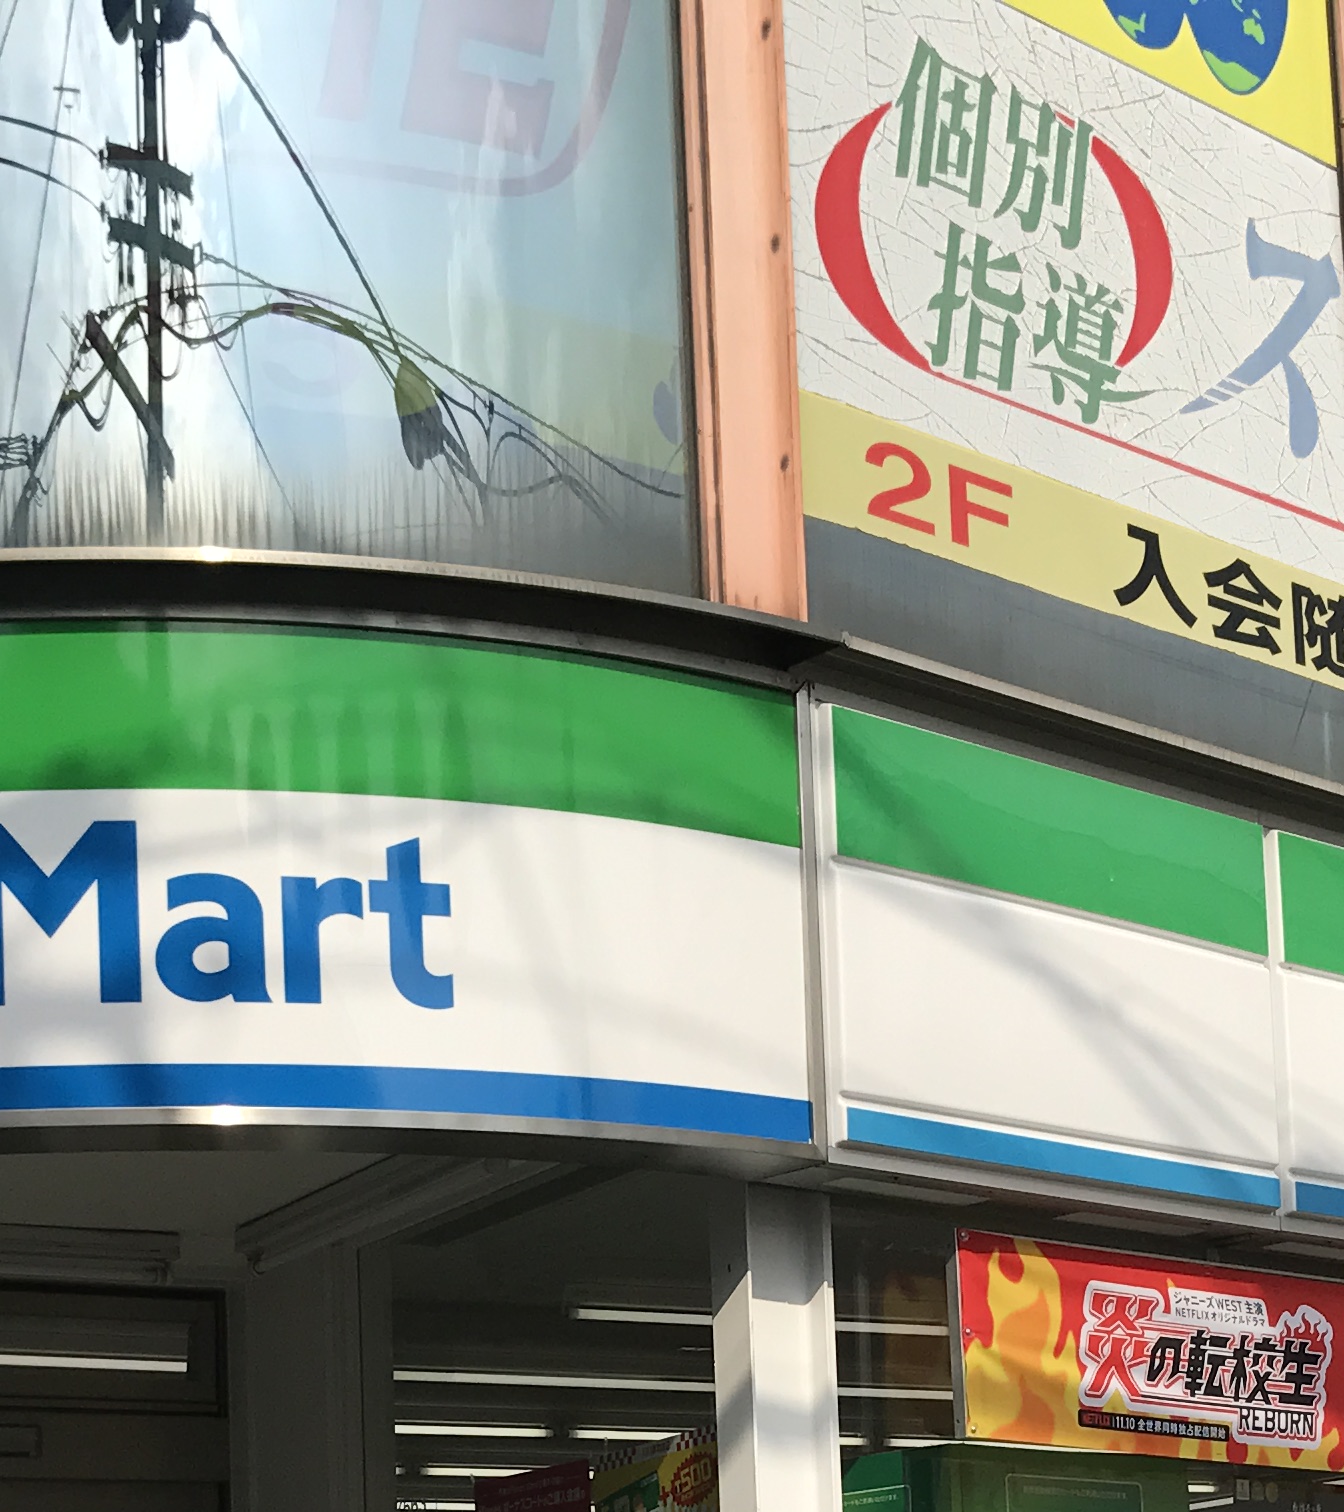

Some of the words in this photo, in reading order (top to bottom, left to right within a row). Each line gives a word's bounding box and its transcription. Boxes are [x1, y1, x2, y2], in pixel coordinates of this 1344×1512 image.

[894, 35, 1093, 250] 個別
[924, 222, 1161, 424] 指導
[865, 441, 1014, 547] 2F
[1085, 1290, 1323, 1406] 炎の転校生
[1238, 1410, 1316, 1437] REBURN
